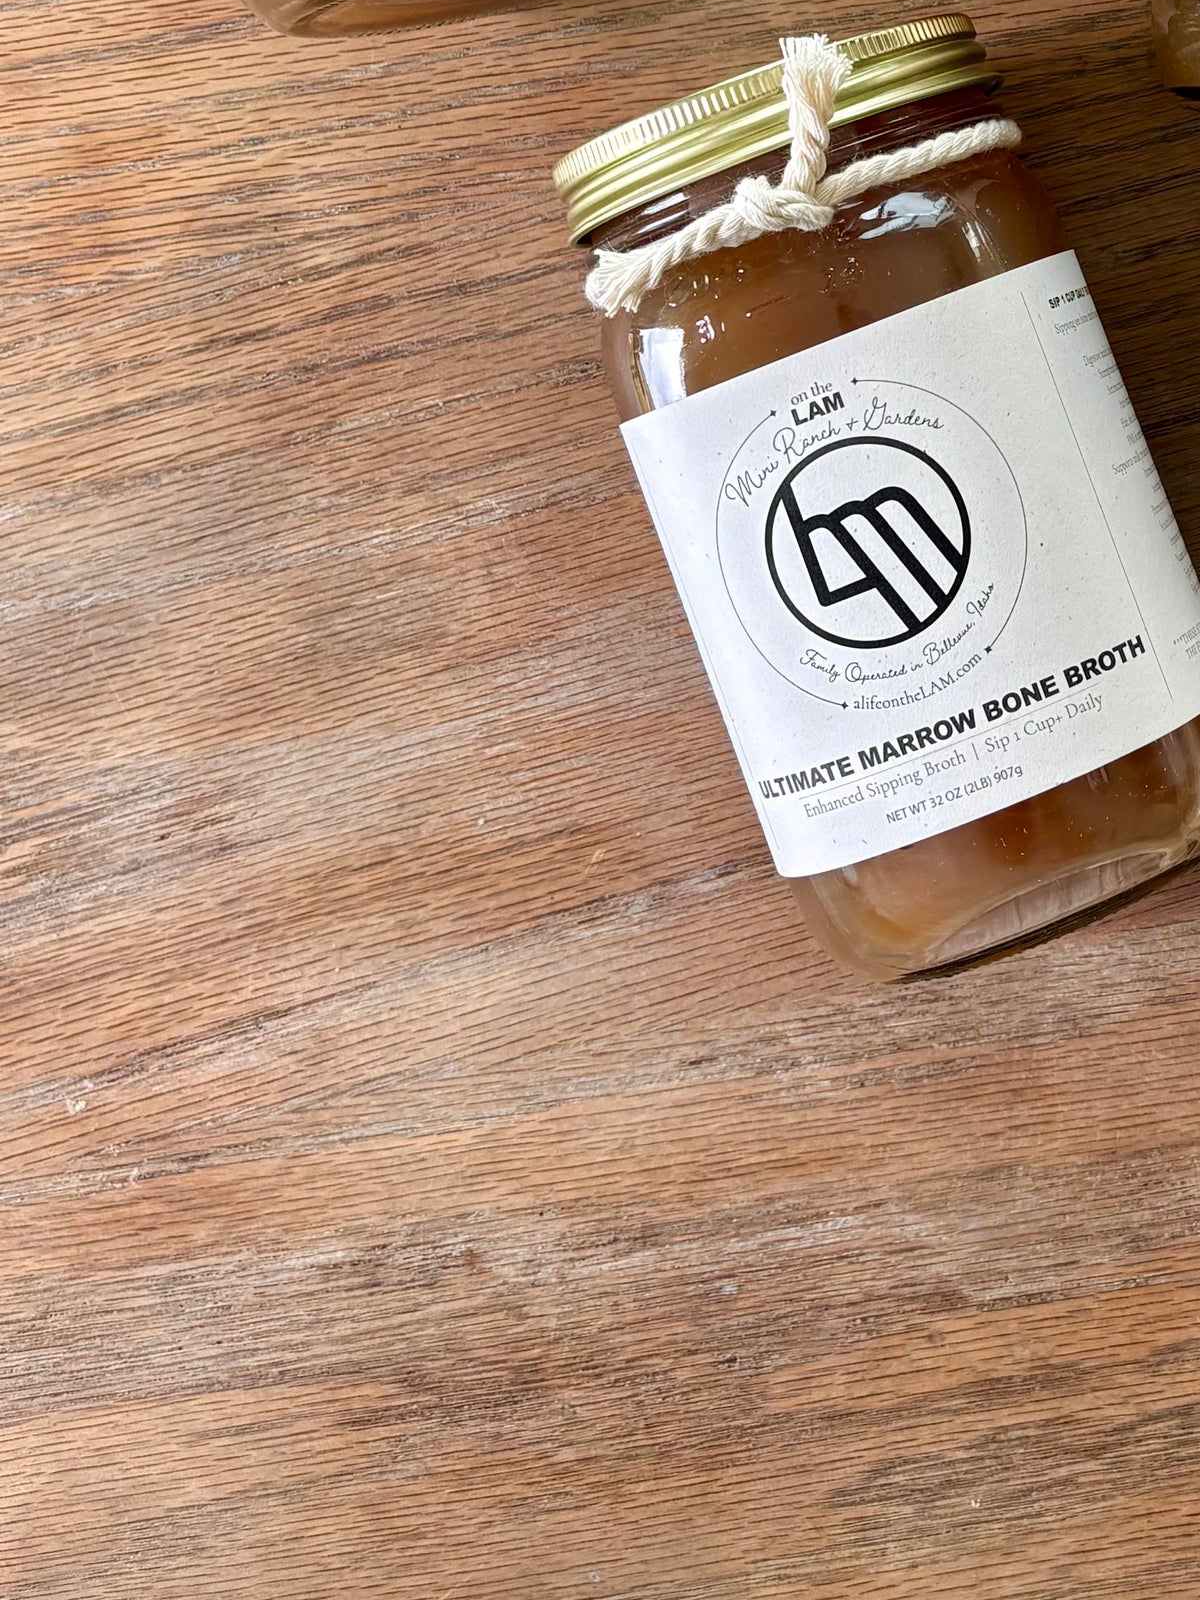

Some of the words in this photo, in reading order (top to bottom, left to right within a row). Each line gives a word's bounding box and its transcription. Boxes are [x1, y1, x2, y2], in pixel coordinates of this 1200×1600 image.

[1048, 296, 1060, 309] SIP
[790, 392, 808, 406] on
[810, 381, 833, 399] the
[790, 391, 845, 426] LAM
[725, 456, 779, 507] Mini
[773, 421, 841, 464] Ranch
[863, 397, 944, 431] Gardens
[800, 648, 840, 682] Family
[844, 661, 908, 684] Operated
[911, 661, 923, 671] in
[966, 582, 994, 617] Idaho
[853, 654, 982, 710] alifeontheLAM.com
[758, 756, 855, 800] ULTIMATE
[857, 708, 977, 770] MARROW
[984, 675, 1060, 723] BONE
[1063, 634, 1147, 688] BROTH
[803, 786, 864, 818] Enhanced
[865, 766, 924, 799] Sipping
[924, 750, 968, 778] Broth
[985, 735, 1011, 756] Sip
[1013, 732, 1022, 742] 1
[1023, 714, 1064, 738] Cup+
[1066, 693, 1104, 720] Daily
[886, 808, 910, 824] NET
[906, 801, 929, 816] WT
[930, 795, 945, 809] 32
[944, 788, 965, 804] OZ
[963, 777, 993, 800] (2LB)
[994, 765, 1024, 784] 907g
